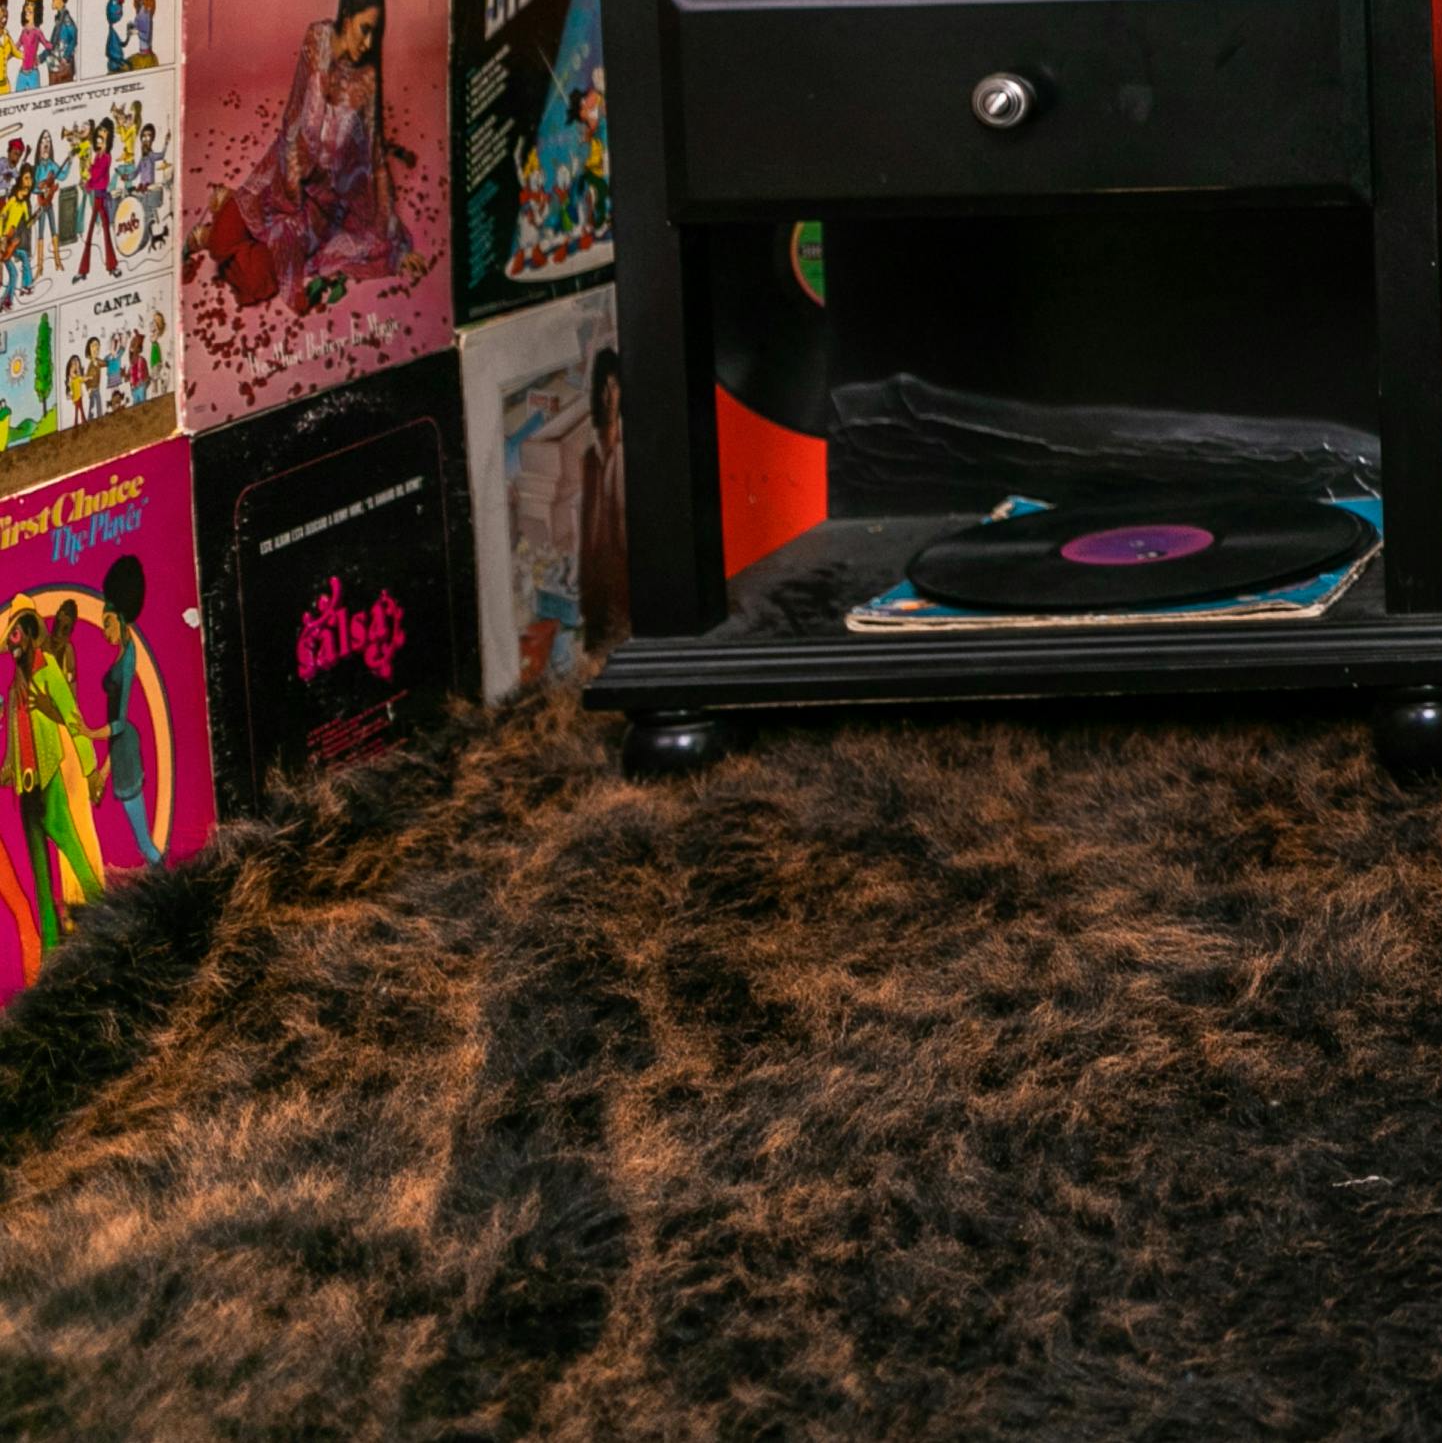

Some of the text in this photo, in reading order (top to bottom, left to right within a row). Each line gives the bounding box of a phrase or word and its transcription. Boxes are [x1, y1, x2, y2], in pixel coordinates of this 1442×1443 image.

[31, 99, 51, 112] ME
[56, 92, 84, 107] HOW
[87, 87, 111, 101] YOU
[113, 81, 145, 96] FEEL
[94, 290, 142, 316] CANTA
[0, 474, 145, 550] irst Choice
